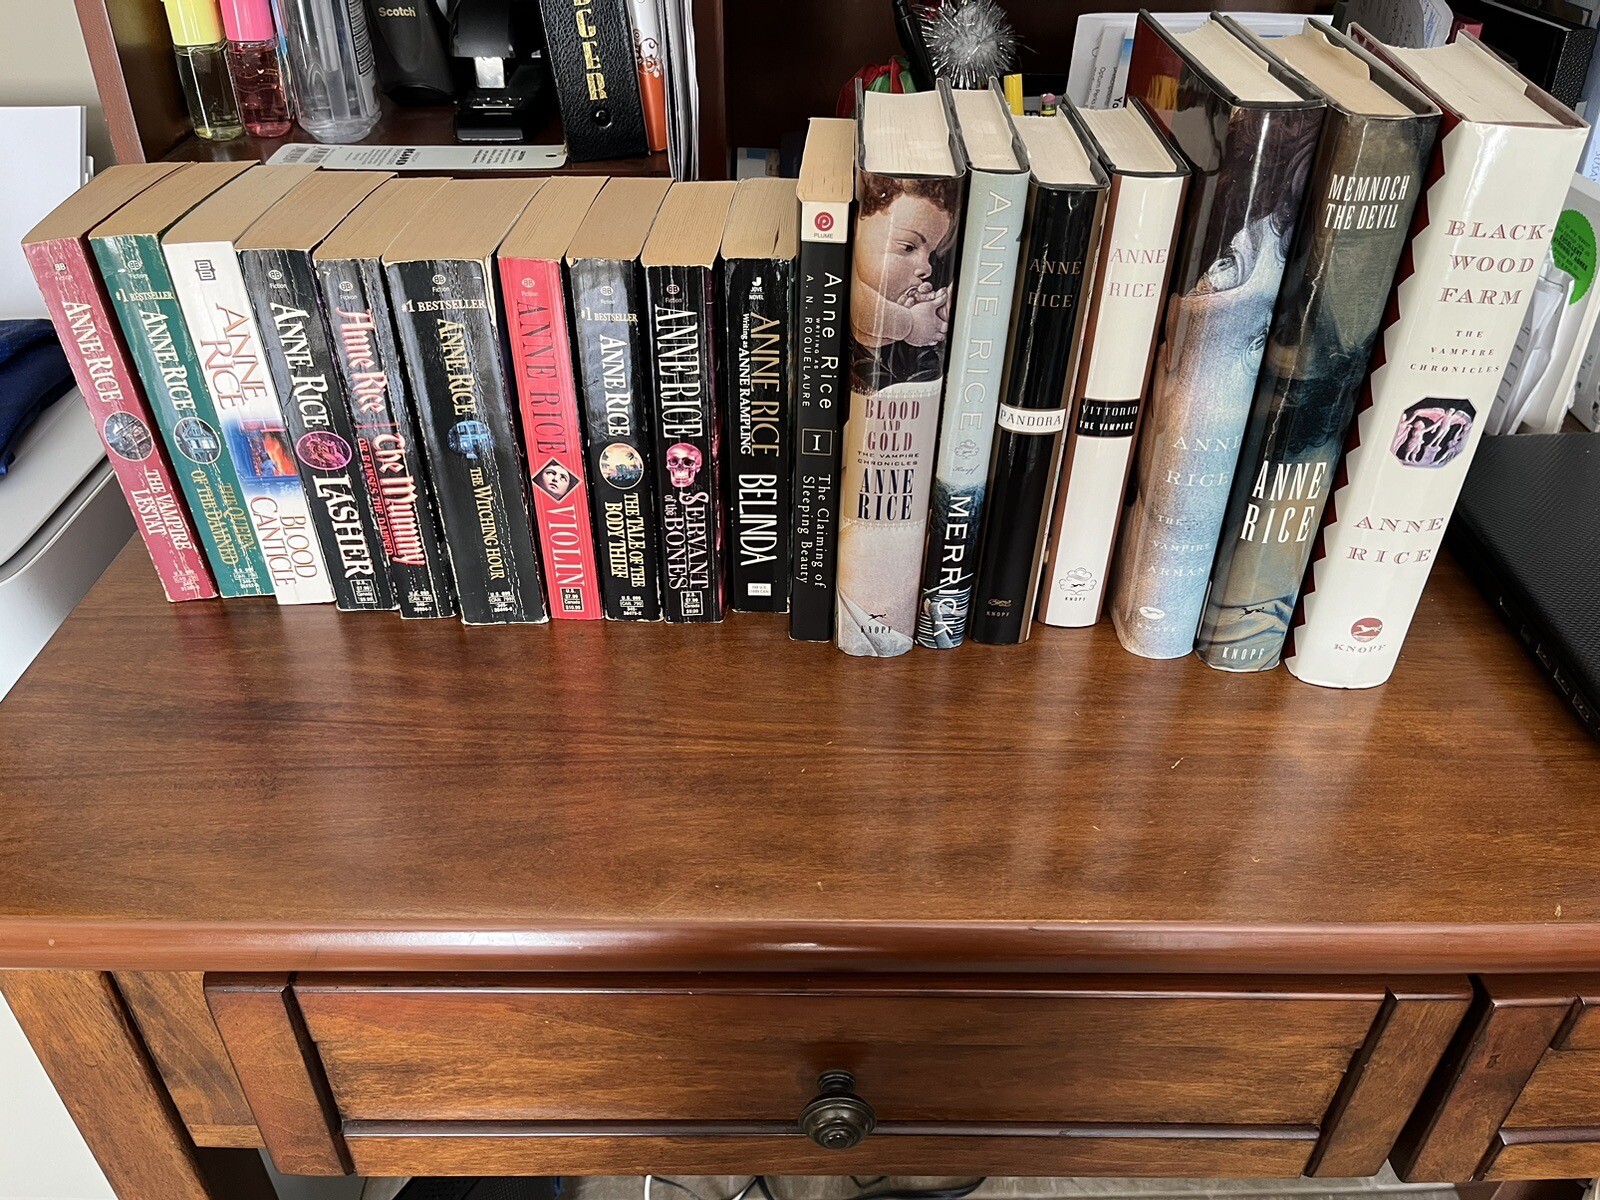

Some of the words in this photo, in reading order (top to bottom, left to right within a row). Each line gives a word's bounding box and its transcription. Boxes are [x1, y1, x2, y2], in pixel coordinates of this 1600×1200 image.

[379, 7, 416, 18] Scotch
[573, 0, 608, 100] GER
[1328, 174, 1410, 201] MEMNOCH
[1324, 204, 1352, 229] THE
[1357, 204, 1398, 230] DEVIL
[972, 190, 1012, 317] ANNE
[1029, 259, 1082, 276] ANNE
[1110, 248, 1167, 264] ANNE
[1449, 254, 1535, 273] WOOD
[129, 291, 175, 302] BESTSELLER
[805, 274, 815, 289] A.
[1109, 282, 1156, 298] RICE
[1438, 287, 1522, 305] FARM
[401, 299, 415, 313] #1
[418, 300, 487, 312] BESTSELLER
[594, 312, 638, 323] BESTSELLER
[805, 295, 814, 310] N.
[822, 272, 843, 339] Anne
[1028, 292, 1073, 308] RICE
[270, 302, 315, 369] ANNE
[336, 307, 376, 370] Anne
[437, 318, 470, 371] ANNE
[516, 299, 558, 379] ANNE
[655, 304, 701, 376] ANNE
[740, 313, 750, 340] Writing
[741, 340, 749, 349] as
[1456, 330, 1484, 339] THE
[62, 300, 105, 355] ANNE
[84, 355, 124, 403] RICE
[139, 310, 179, 364] ANNE
[159, 364, 197, 411] RICE
[215, 302, 268, 399] ANNE
[600, 334, 628, 390] ANNE
[738, 347, 751, 387] ANNE
[750, 311, 780, 393] ANNE
[802, 317, 813, 407] ROQUELAURE
[1410, 363, 1500, 374] CHRONICLES
[1430, 347, 1495, 357] VAMPIRE
[200, 339, 245, 410] RICE
[352, 371, 389, 414] Rice
[819, 356, 839, 409] Rice
[959, 338, 994, 431] RICE
[291, 373, 331, 429] RICE
[448, 373, 477, 416] RICE
[660, 380, 703, 439] RICE
[865, 399, 921, 421] BLOOD
[1082, 404, 1139, 417] VITTORIO
[530, 391, 567, 454] RICE
[604, 391, 631, 437] RICE
[739, 387, 752, 455] RAMPLING
[751, 401, 780, 458] RICE
[882, 420, 901, 432] AND
[1000, 408, 1063, 427] PANDORA
[1079, 420, 1095, 430] THE
[1099, 421, 1134, 431] VAMPIRE
[372, 432, 406, 474] The
[812, 434, 822, 451] I
[857, 450, 876, 458] THE
[867, 431, 913, 451] GOLD
[190, 470, 206, 488] OF
[361, 454, 380, 498] RAMSES
[469, 467, 485, 487] THE
[857, 458, 918, 467] CHRONICLES
[1165, 469, 1230, 487] RICE
[1252, 460, 1327, 501] ANNE
[818, 473, 831, 505] The
[859, 468, 915, 494] ANNE
[130, 488, 166, 536] LESTAT
[144, 468, 166, 494] THE
[155, 494, 193, 550] VAMPIRE
[371, 497, 384, 519] THE
[380, 475, 426, 566] Mummy
[473, 484, 499, 546] WITCHING
[605, 502, 625, 539] BODY
[623, 493, 639, 517] THE
[738, 474, 778, 566] BELINDA
[797, 475, 815, 535] Sleeping
[858, 493, 913, 520] RICE
[1157, 514, 1183, 526] THE
[222, 506, 257, 552] QUEEN
[250, 495, 297, 588] CANTICLE
[312, 474, 375, 578] LASHER
[375, 519, 394, 556] DAMNED
[626, 517, 646, 549] TALE
[679, 491, 710, 589] SERVANT
[811, 508, 830, 569] Claiming
[1240, 503, 1315, 544] RICE
[1354, 516, 1444, 533] ANNE
[280, 515, 318, 578] BLOOD
[484, 546, 505, 581] HOUR
[546, 504, 586, 587] VIOLIN
[608, 541, 629, 579] THIEF
[629, 550, 647, 565] OF
[664, 517, 689, 590] BONES
[796, 541, 813, 584] Beauty
[1153, 540, 1212, 552] VAMPIRE
[1345, 546, 1432, 565] RICE
[631, 565, 647, 588] THE
[814, 571, 827, 589] of
[933, 495, 972, 636] MERRICK
[861, 625, 893, 634] KNOPF
[985, 610, 1011, 618] KNOPF
[1222, 646, 1265, 660] KNOPF
[1334, 643, 1386, 653] KNOPF
